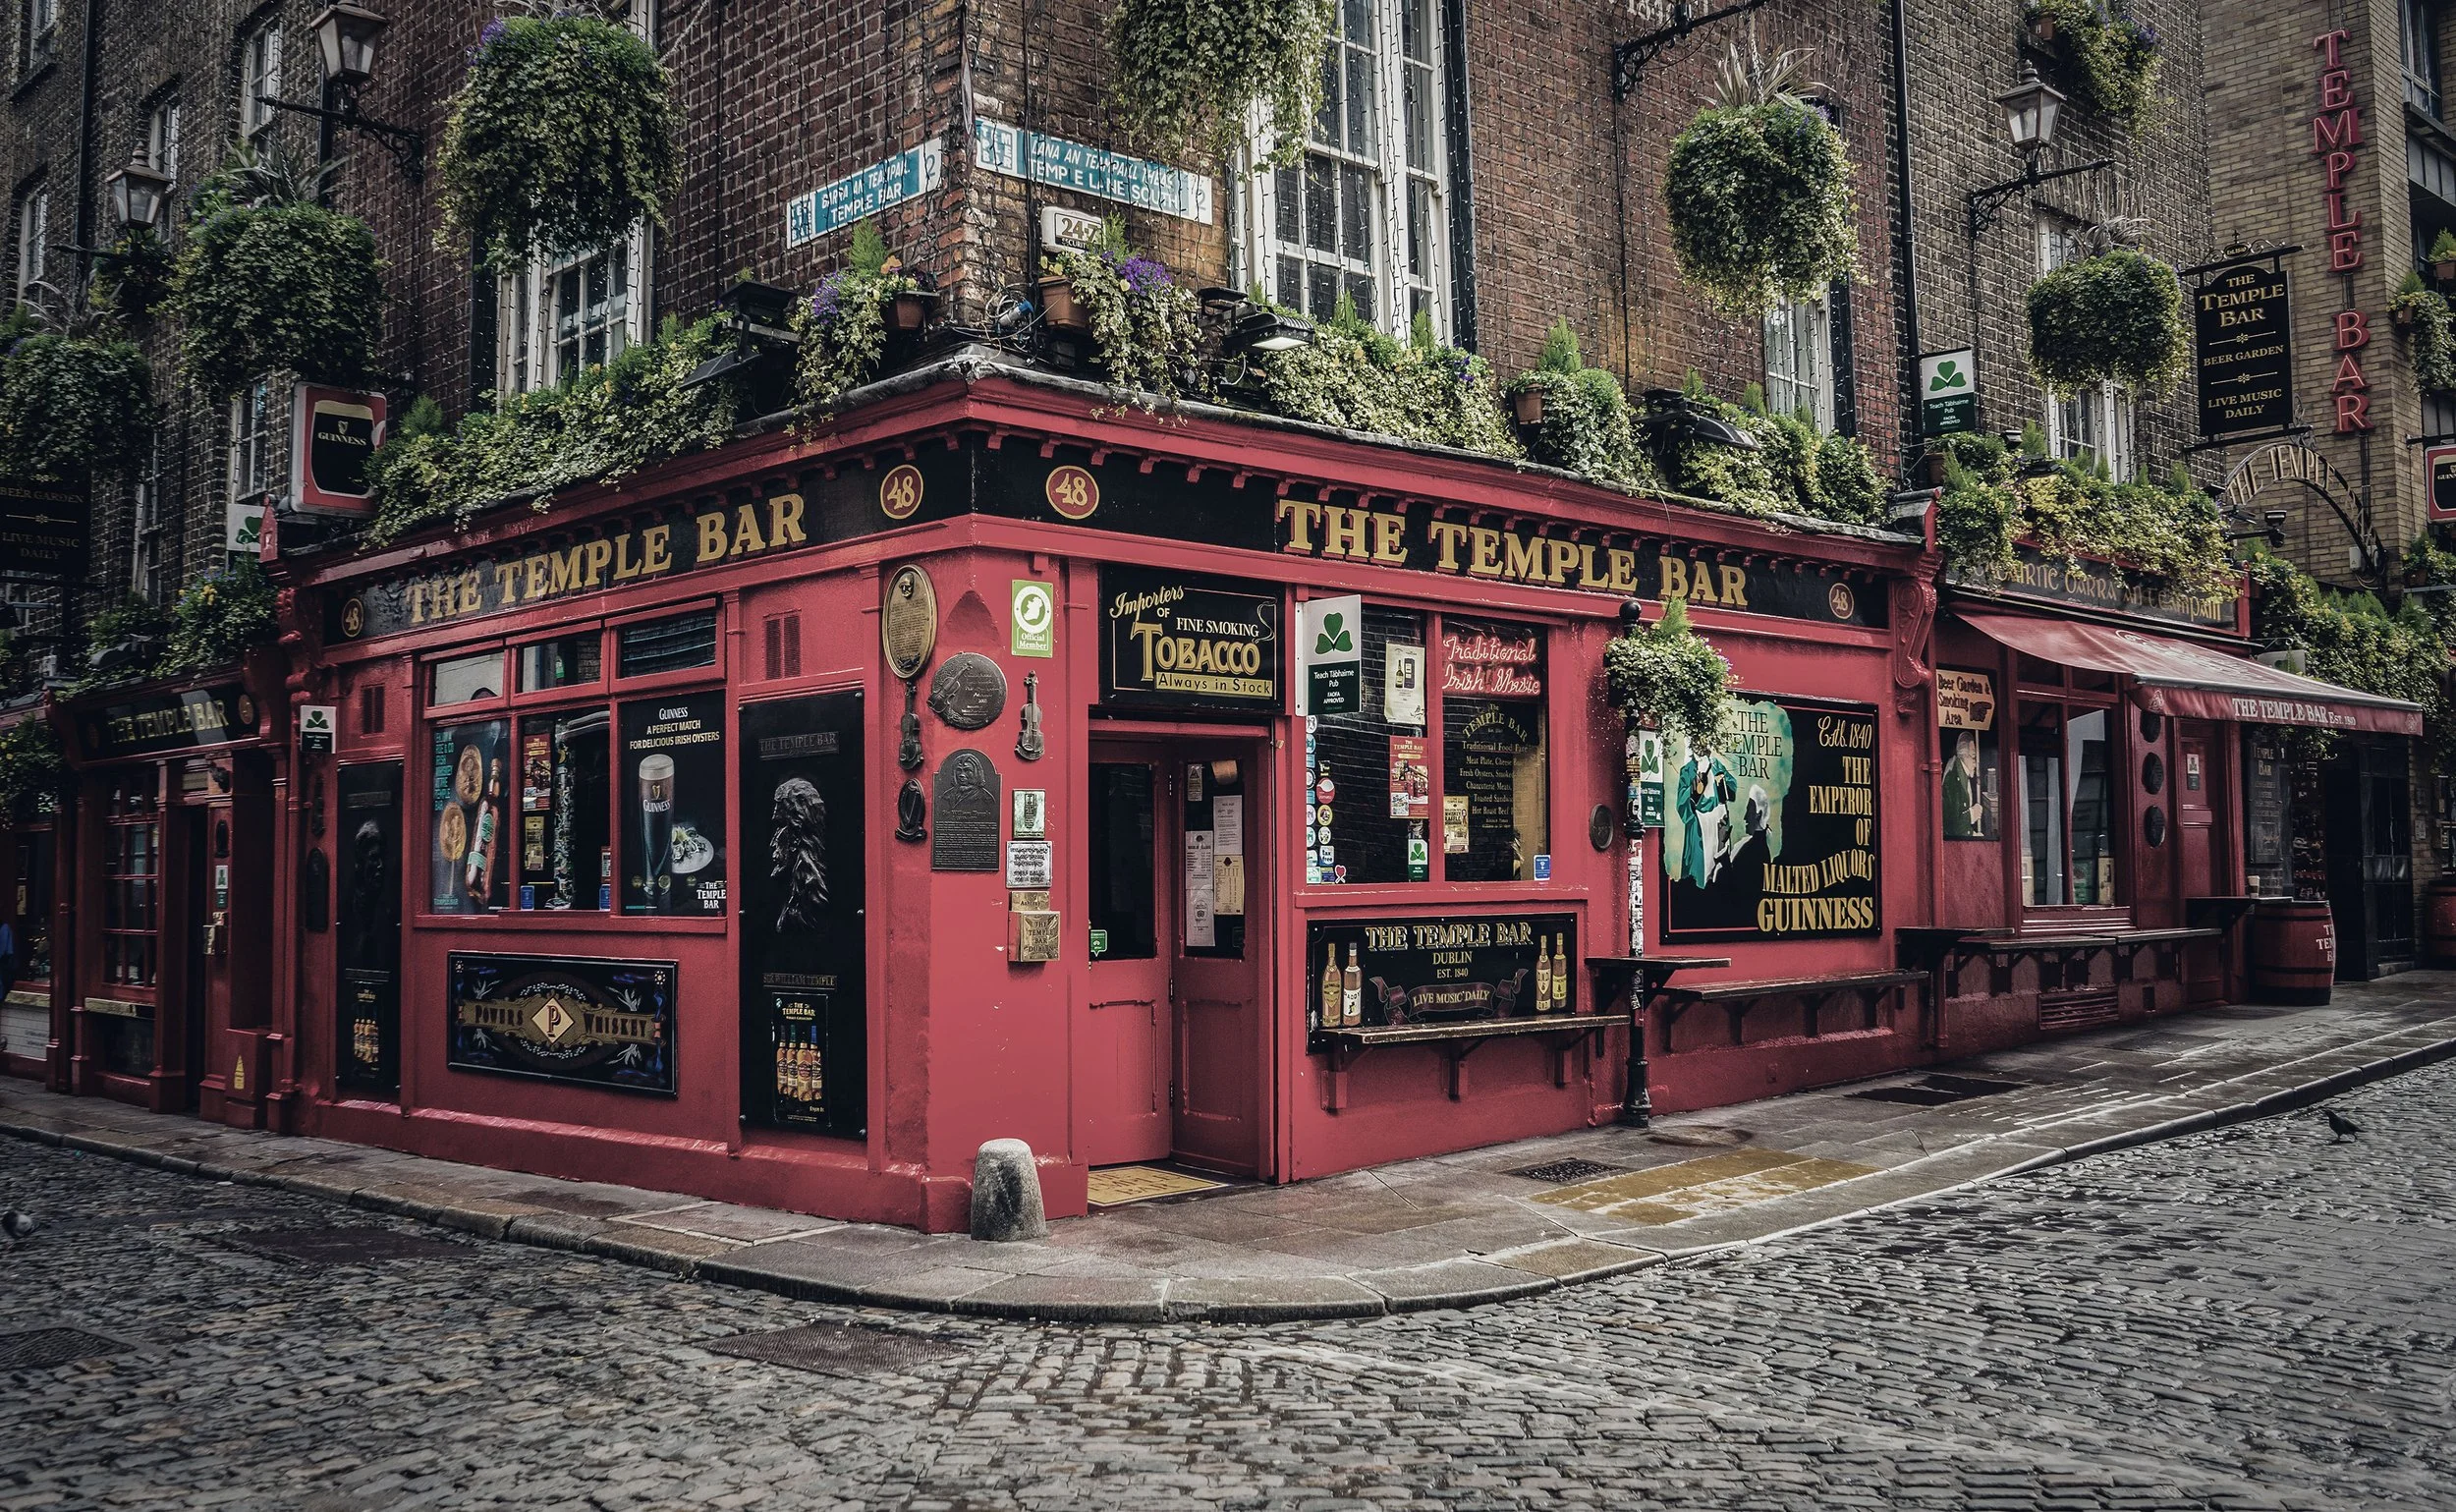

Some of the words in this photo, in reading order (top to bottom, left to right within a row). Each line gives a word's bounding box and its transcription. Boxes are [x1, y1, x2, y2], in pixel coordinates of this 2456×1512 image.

[1065, 146, 1081, 165] AN
[2312, 28, 2366, 273] TEMPLE
[830, 193, 873, 225] TEMPLE
[926, 154, 937, 178] 2
[1131, 184, 1178, 209] SOUTH
[2226, 274, 2256, 288] THE
[2200, 284, 2284, 311] TEMPLE
[2219, 308, 2266, 328] BAR
[2204, 354, 2233, 366] BEER
[2235, 345, 2284, 362] GARDEN
[2330, 309, 2374, 435] BAR
[2208, 395, 2237, 408] LIVE
[2240, 389, 2282, 404] MUSIC
[2225, 405, 2264, 419] DAILY
[317, 431, 367, 446] GUINNESS
[2226, 457, 2263, 506] THE
[2267, 444, 2335, 491] TEMPLE
[886, 476, 916, 510] 48
[1055, 473, 1088, 507] 48
[408, 568, 484, 625] THE
[496, 524, 674, 607] TEMPLE
[697, 491, 808, 564] BAR
[1279, 498, 1409, 566] THE
[1430, 521, 1640, 595] TEMPLE
[1659, 555, 1750, 610] BAR
[1109, 585, 1185, 622] Importers
[1833, 587, 1850, 612] 48
[1156, 607, 1171, 618] OF
[1021, 633, 1045, 642] Official
[1176, 617, 1204, 632] FINE
[1205, 620, 1260, 638] SMOKING
[1019, 641, 1047, 649] Member
[1130, 622, 1261, 682] TOBACCO
[1442, 636, 1536, 661] Traditional
[1158, 673, 1208, 690] Always
[1215, 678, 1227, 689] in
[1233, 678, 1270, 694] Stock
[1313, 671, 1329, 680] Teach
[1442, 663, 1484, 691] Irish
[1491, 668, 1540, 694] Music
[1937, 674, 1955, 691] Beer
[1956, 676, 1983, 694] Garden
[1938, 692, 1969, 712] Smoking
[2232, 698, 2258, 718] THE
[2258, 699, 2306, 722] TEMPLE
[2306, 704, 2329, 725] BAR
[193, 700, 230, 731] BAR
[659, 706, 689, 720] GUINNESS
[1738, 710, 1768, 733] THE
[1945, 709, 1963, 725] Area
[646, 726, 652, 735] A
[652, 722, 679, 735] PERFECT
[679, 719, 701, 732] MATCH
[1463, 712, 1505, 738] TEMPLE
[1508, 717, 1529, 743] BAR
[1849, 722, 1872, 750] 1840
[630, 740, 642, 750] FOR
[642, 735, 675, 748] DELICIOUS
[675, 734, 692, 746] IRISH
[692, 731, 720, 744] OYSTERS
[817, 732, 836, 746] BAR
[1461, 741, 1496, 752] Traditional
[1498, 742, 1513, 752] Food
[1725, 735, 1783, 756] TEMPLE
[1460, 768, 1474, 777] Fresh
[1738, 756, 1770, 780] BAR
[1842, 756, 1871, 785] THE
[2258, 760, 2272, 776] BAR
[642, 799, 671, 812] GUINNESS
[1474, 794, 1493, 803] Toasted
[1809, 785, 1872, 815] EMPEROR
[1472, 806, 1481, 814] Hot
[1482, 806, 1497, 815] Roast
[1498, 806, 1510, 815] Beef
[1856, 818, 1872, 846] OF
[1761, 862, 1819, 895] MALTED
[1820, 848, 1875, 888] LIQUORS
[697, 889, 727, 899] TEMPLE
[703, 900, 719, 909] BAR
[1757, 896, 1874, 932] GUINNESS
[1365, 926, 1409, 952] THE
[1413, 924, 1491, 950] TEMPLE
[1496, 922, 1535, 946] BAR
[1432, 951, 1473, 965] DUBLIN
[1436, 968, 1453, 980] EST.
[1454, 968, 1469, 978] 1840
[1413, 993, 1434, 1007] LIVE
[1434, 991, 1462, 1004] MUSIC
[1465, 989, 1491, 1003] DAILY
[474, 1004, 524, 1027] POWERS
[583, 1012, 647, 1037] WHISKEY
